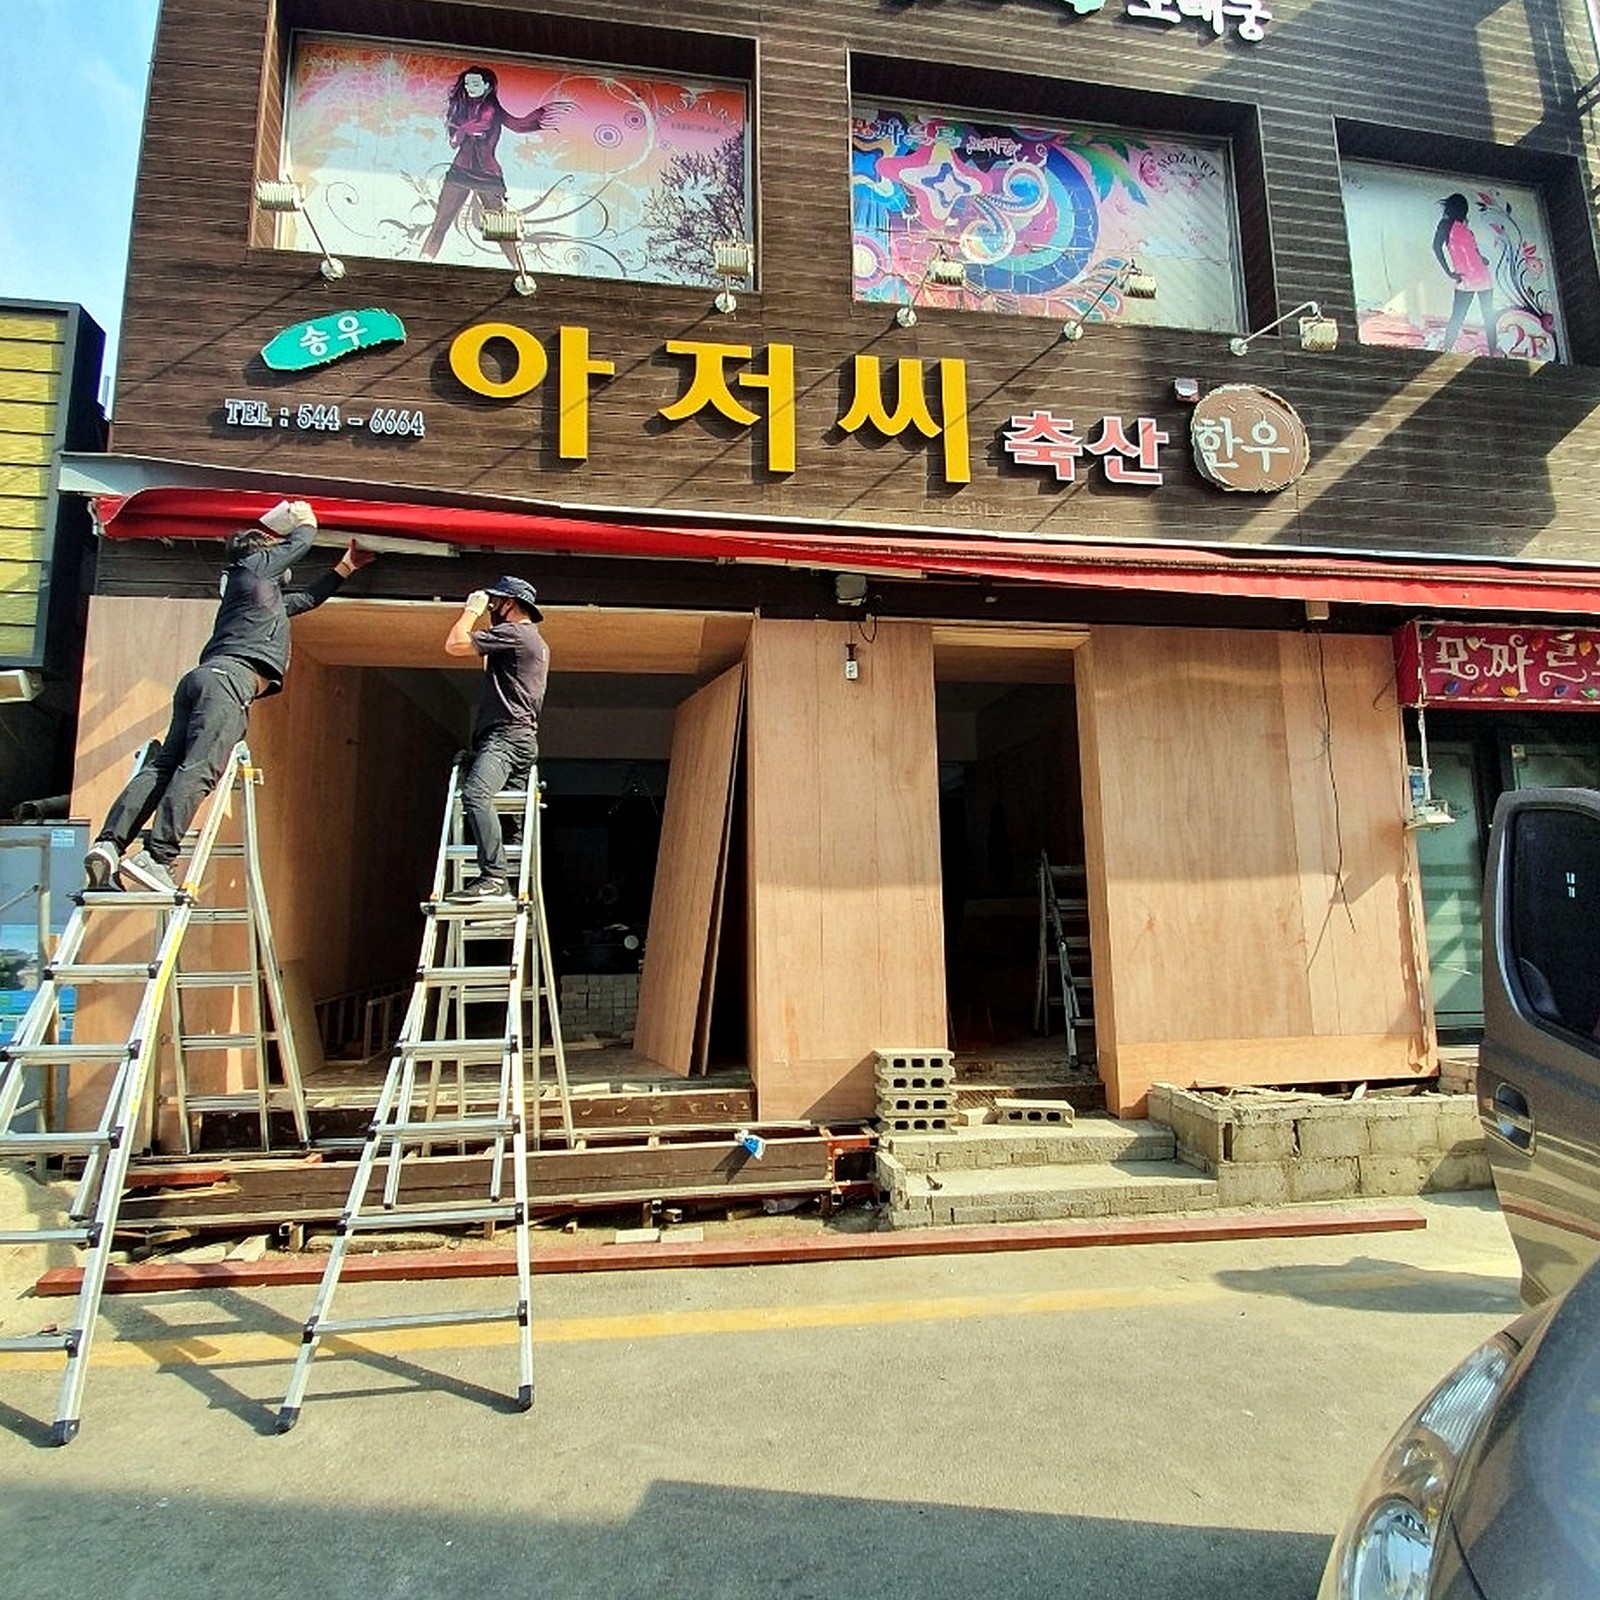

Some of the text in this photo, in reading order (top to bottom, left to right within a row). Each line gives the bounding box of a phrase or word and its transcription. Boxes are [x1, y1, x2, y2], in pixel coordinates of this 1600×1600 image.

[300, 316, 368, 357] 송우
[1500, 324, 1548, 358] 2F
[1002, 410, 1170, 486] 축산
[1197, 415, 1291, 473] 한우
[1430, 634, 1600, 693] 모짜르
